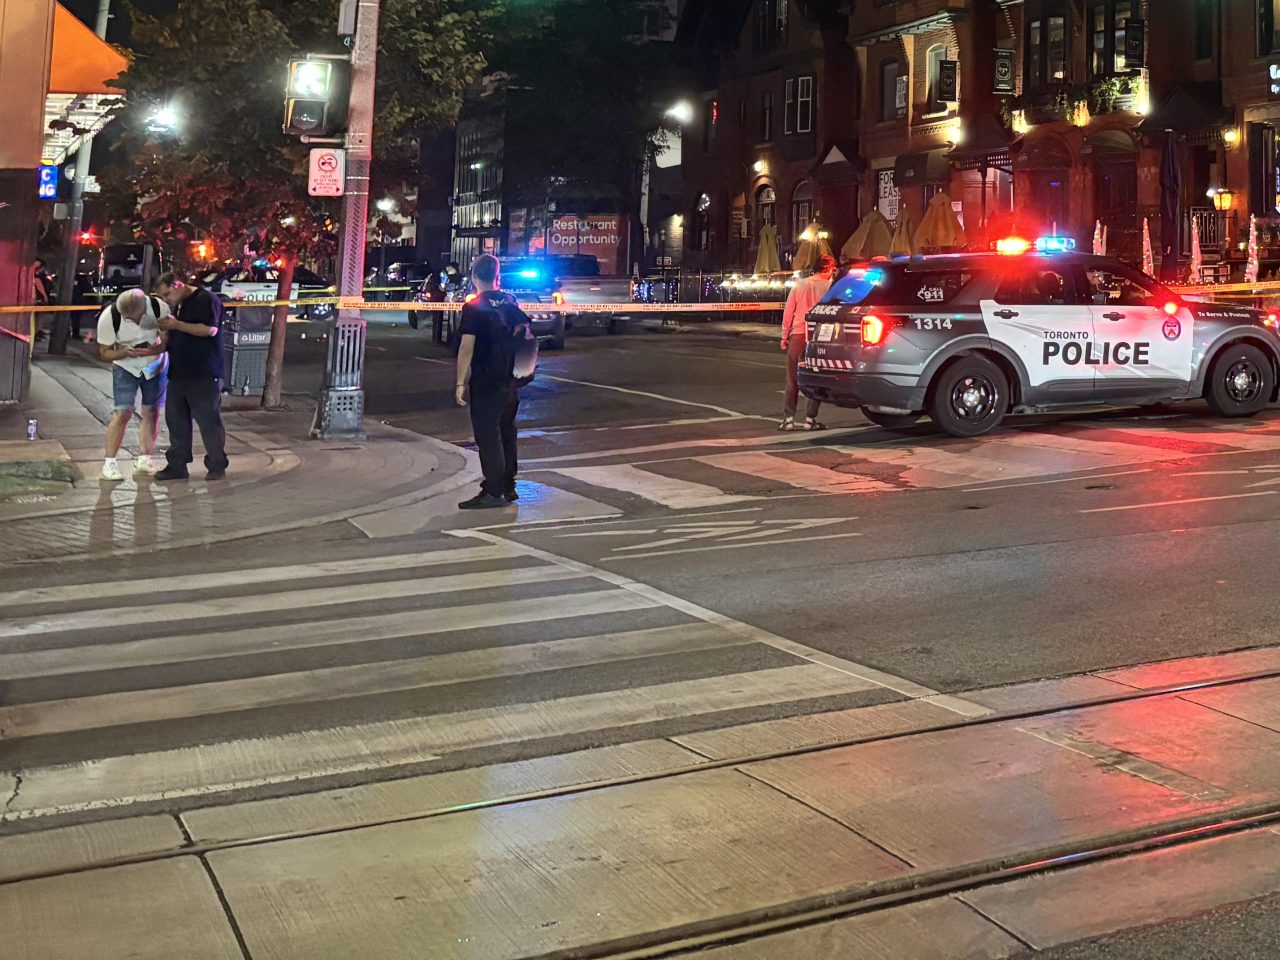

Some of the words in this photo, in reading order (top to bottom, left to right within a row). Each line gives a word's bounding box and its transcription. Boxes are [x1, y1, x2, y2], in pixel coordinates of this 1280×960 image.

[879, 172, 894, 185] FOR
[924, 290, 944, 300] 911
[811, 304, 842, 315] POLICE
[914, 318, 953, 330] 1314
[248, 332, 266, 341] Litter
[1043, 330, 1089, 340] TORONTO
[1042, 341, 1150, 366] POLICE
